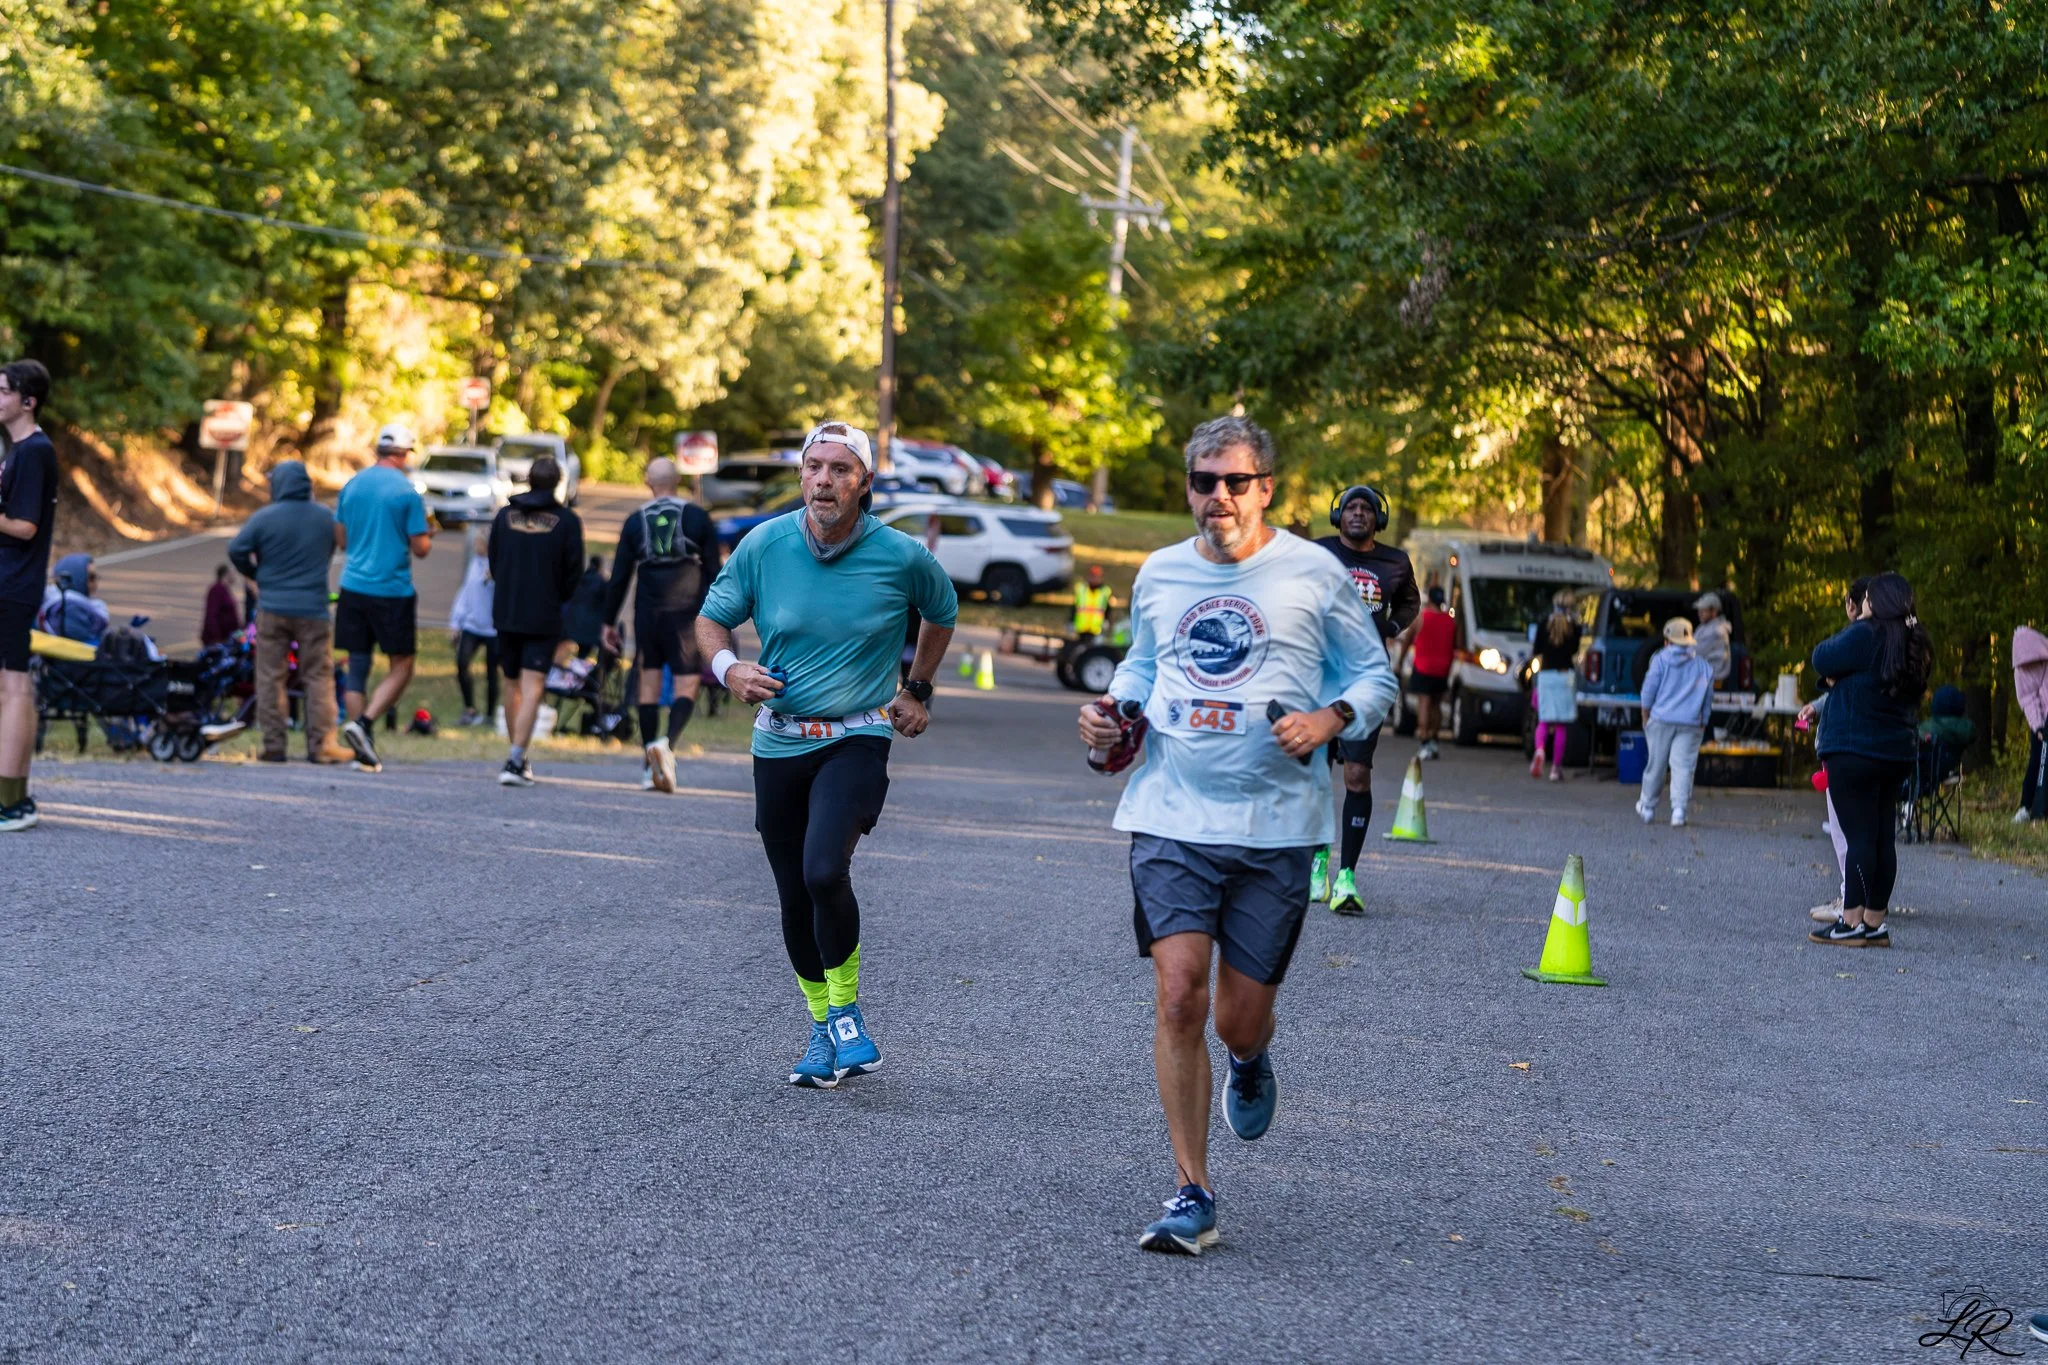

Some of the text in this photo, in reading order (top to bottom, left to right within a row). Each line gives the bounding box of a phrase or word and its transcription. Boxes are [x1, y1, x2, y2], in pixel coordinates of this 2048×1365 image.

[1179, 610, 1198, 635] ROAD
[1198, 600, 1220, 613] RACE
[1223, 600, 1252, 616] SERIES
[800, 723, 832, 738] 141
[1190, 708, 1236, 731] 645
